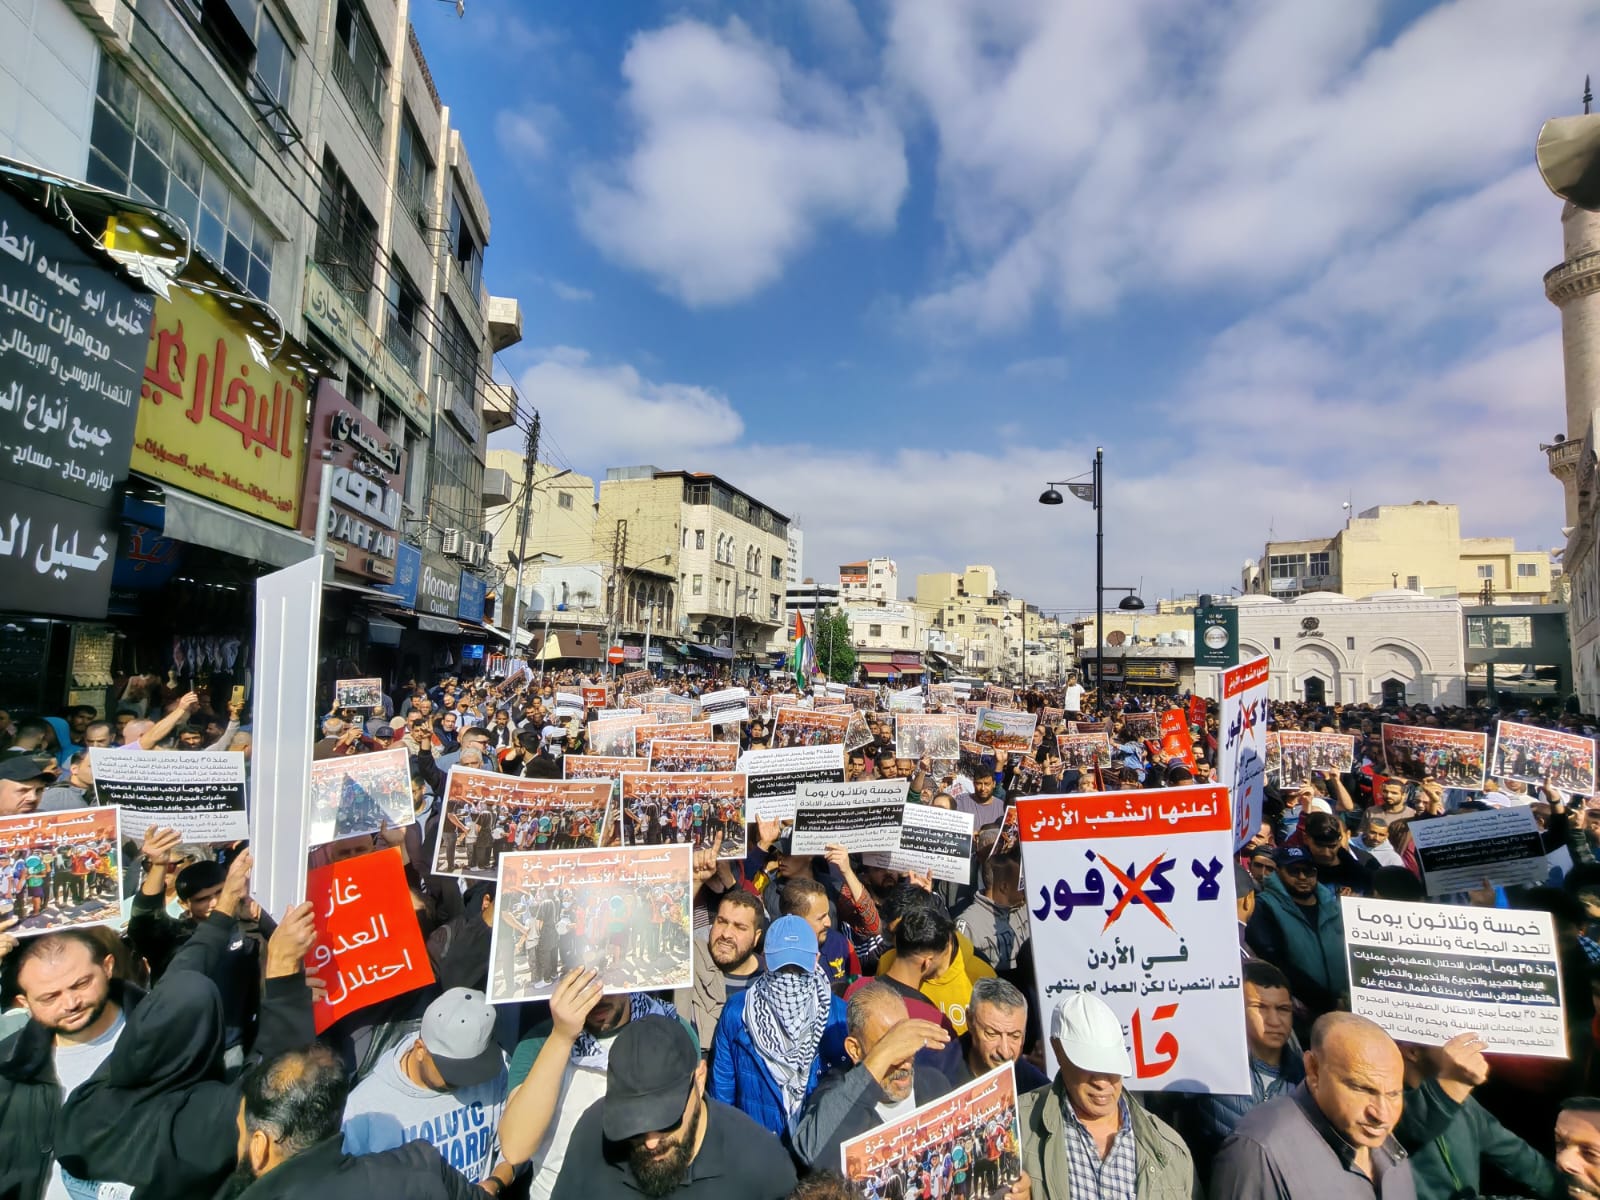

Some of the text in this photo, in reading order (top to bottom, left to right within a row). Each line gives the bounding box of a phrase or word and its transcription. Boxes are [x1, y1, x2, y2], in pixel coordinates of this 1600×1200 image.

[0, 220, 144, 336] خليل ابو عبده الط
[0, 284, 111, 361] مجوهرات تقليد
[50, 356, 60, 376] و
[59, 364, 101, 393] الروسي
[24, 393, 112, 456] جميع أنواع
[12, 444, 114, 491] لوازم حجاج مسابح
[35, 523, 109, 580] خليل
[430, 599, 450, 616] Outlet
[468, 776, 486, 788] غزة
[511, 784, 558, 794] الحصار
[560, 786, 596, 795] كسر
[869, 785, 902, 795] خمسة
[184, 801, 215, 811] شهيد
[466, 789, 593, 810] مسؤولية الأنظمة العربية
[0, 814, 96, 832] كسر الحص
[1030, 792, 1218, 839] أعلنها الشعب الأردني
[35, 831, 96, 846] مسؤولية
[522, 851, 671, 873] كسر الحصار على غزة
[522, 868, 671, 890] مسؤولية الأنظمة العربية
[1191, 856, 1224, 901] لا
[324, 877, 362, 918] غاز
[1407, 912, 1479, 934] وثلاثون
[1483, 916, 1541, 936] خمسة
[315, 913, 390, 968] العدو
[1352, 927, 1551, 958] تتجدد المجاعة وتستمر الابادة
[1088, 937, 1189, 979] في الأردن
[1354, 951, 1387, 961] عمليات
[1388, 954, 1431, 966] الصهيوني
[1433, 959, 1464, 969] الاحتلال
[325, 948, 413, 1006] احتلال
[1373, 967, 1413, 979] والتخريب
[1519, 963, 1532, 973] ٣٥
[1536, 963, 1556, 976] منذ
[1045, 979, 1081, 998] ينتهي
[1083, 980, 1098, 994] لم
[1100, 981, 1137, 997] العمل
[1168, 978, 1215, 996] انتصرنا
[1218, 976, 1241, 990] لقد
[1360, 976, 1377, 986] غزة
[1378, 979, 1403, 989] قطاع
[1404, 982, 1430, 992] شمال
[1431, 984, 1464, 997] منطقة
[1465, 989, 1492, 999] لسكان
[1391, 1000, 1439, 1011] الصهيوني
[1490, 1023, 1534, 1033] المساعدات
[963, 1079, 998, 1111] كسر
[912, 1099, 961, 1136] الحصار
[865, 1135, 886, 1155] غزة
[866, 1101, 1001, 1172] مسؤولية الأنظمة العربية
